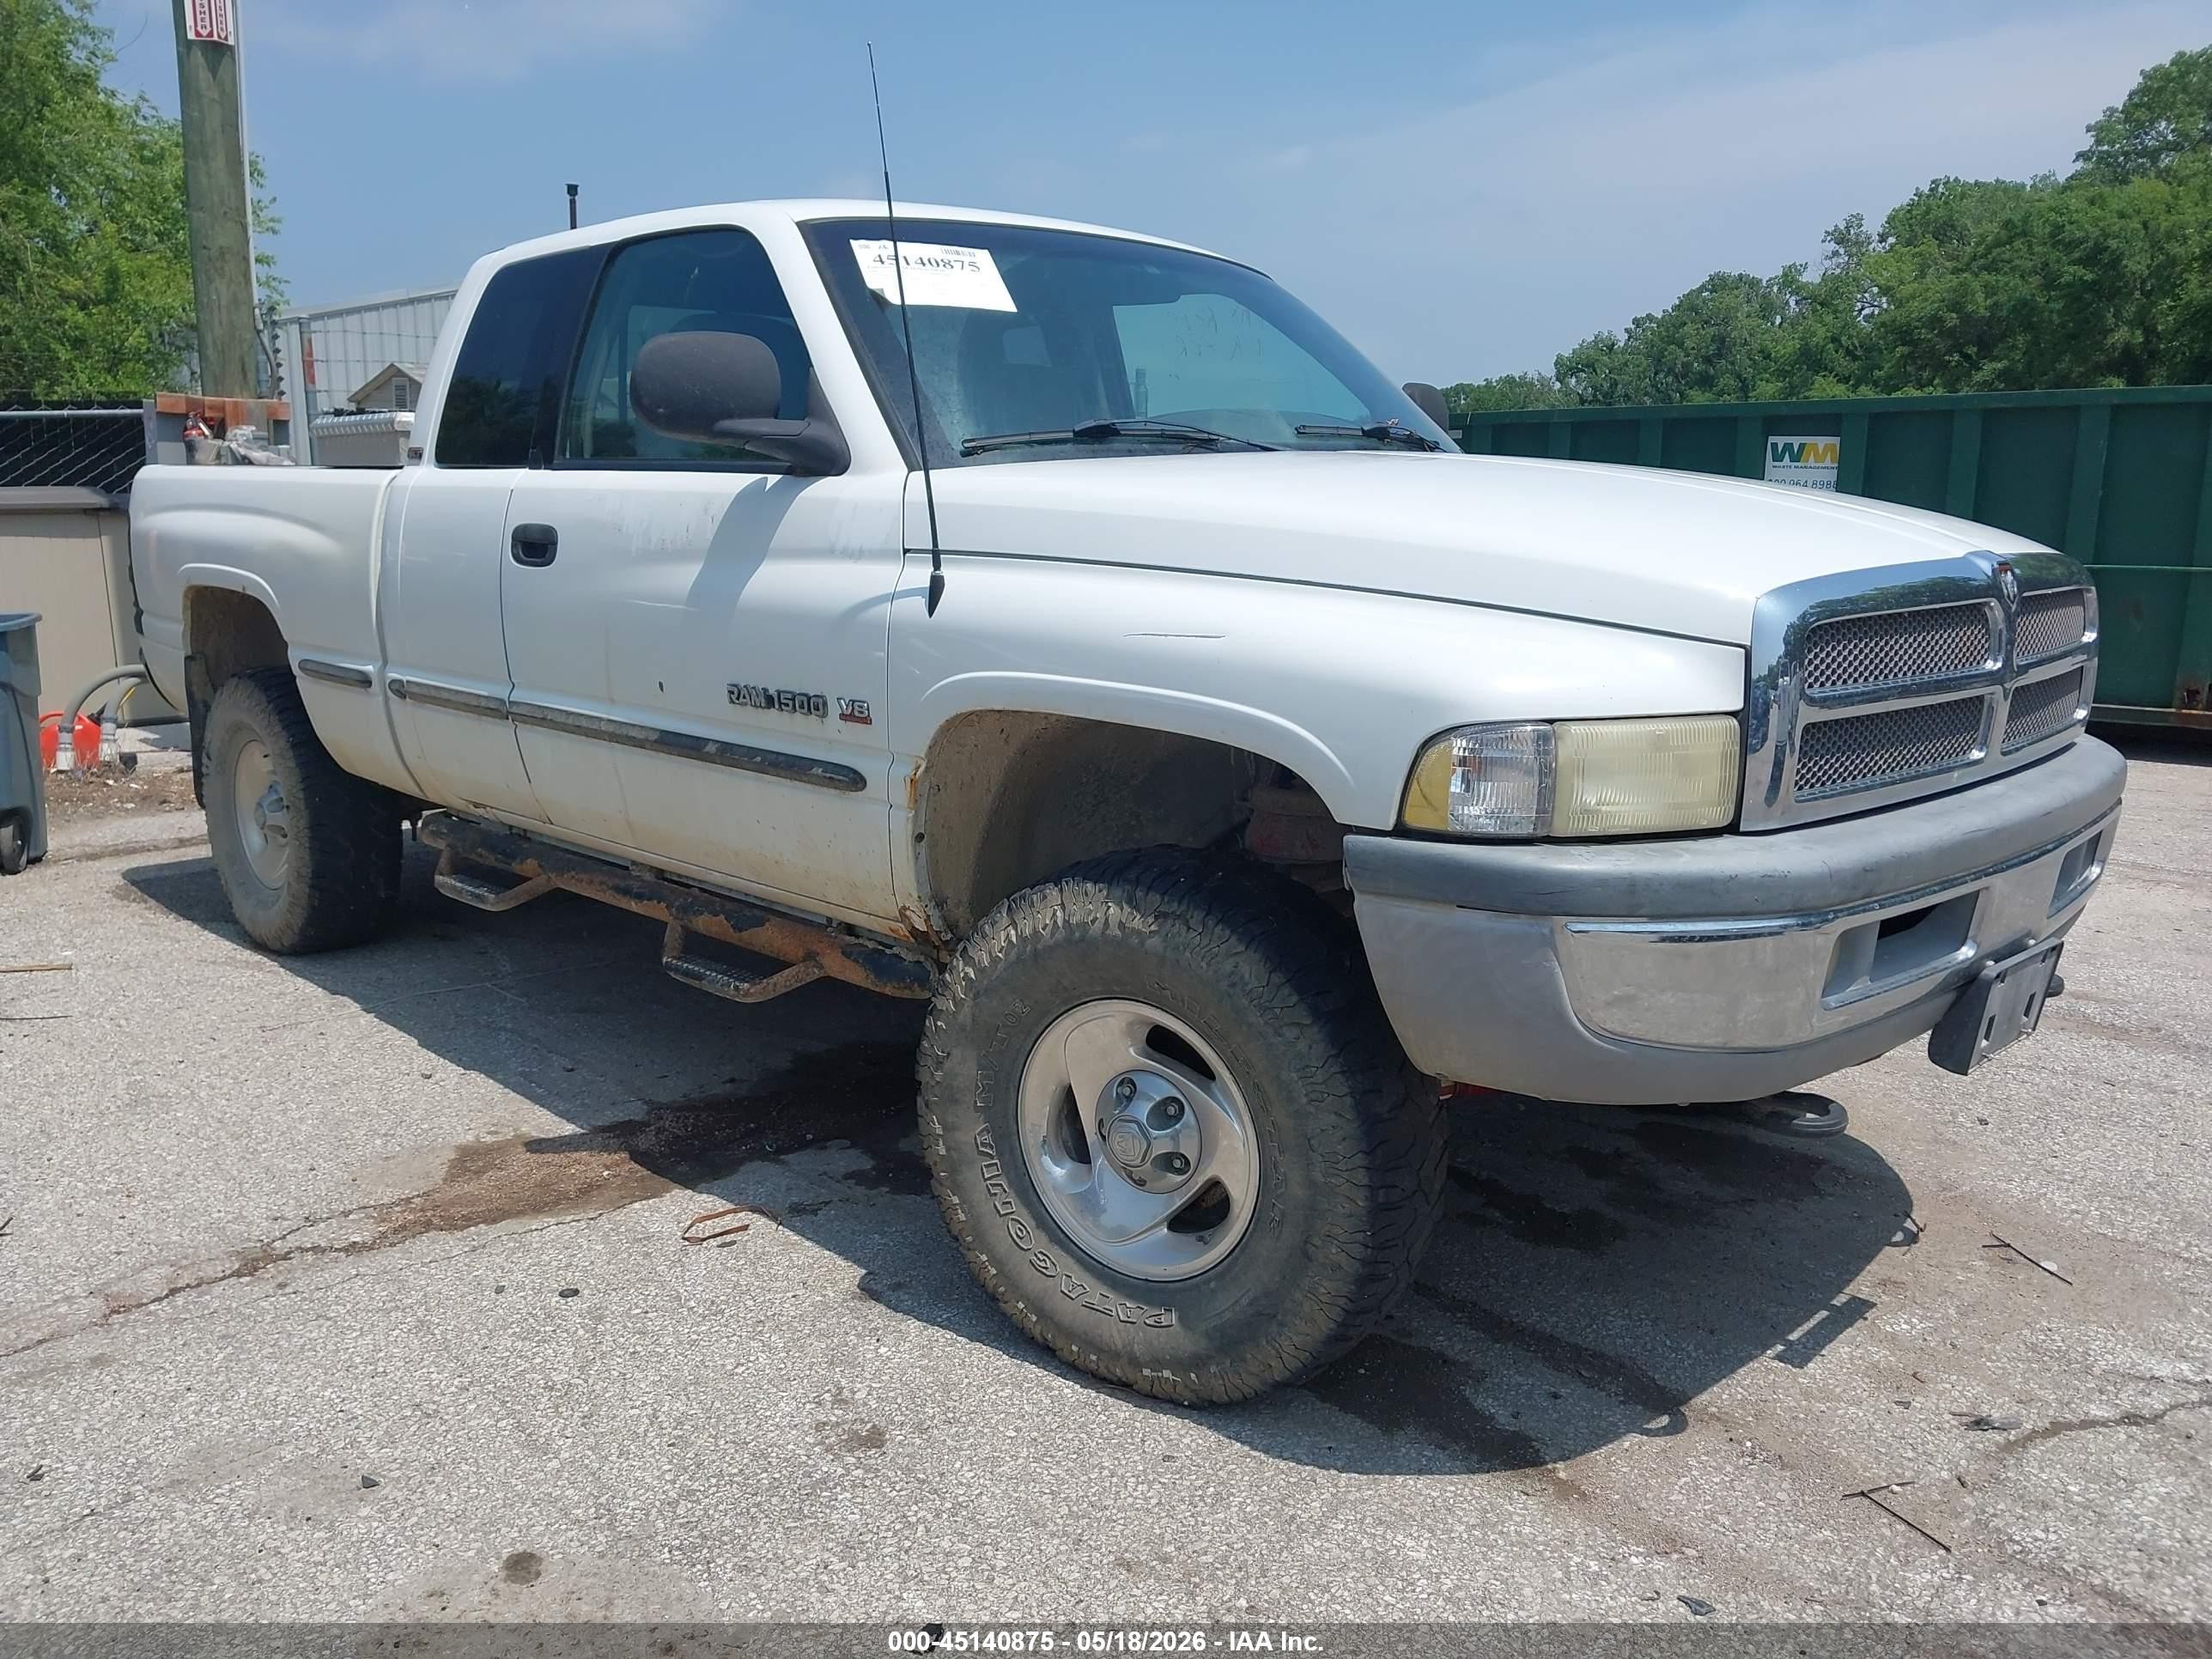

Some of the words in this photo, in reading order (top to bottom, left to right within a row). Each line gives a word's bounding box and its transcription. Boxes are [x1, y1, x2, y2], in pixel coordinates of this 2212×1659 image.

[198, 0, 207, 30] SHER
[872, 253, 981, 272] 45140875
[1770, 441, 1838, 464] WM
[726, 683, 771, 709] RAM
[773, 689, 829, 718] 1500
[836, 696, 870, 718] V8
[975, 1122, 1176, 1328] PATAGONIA
